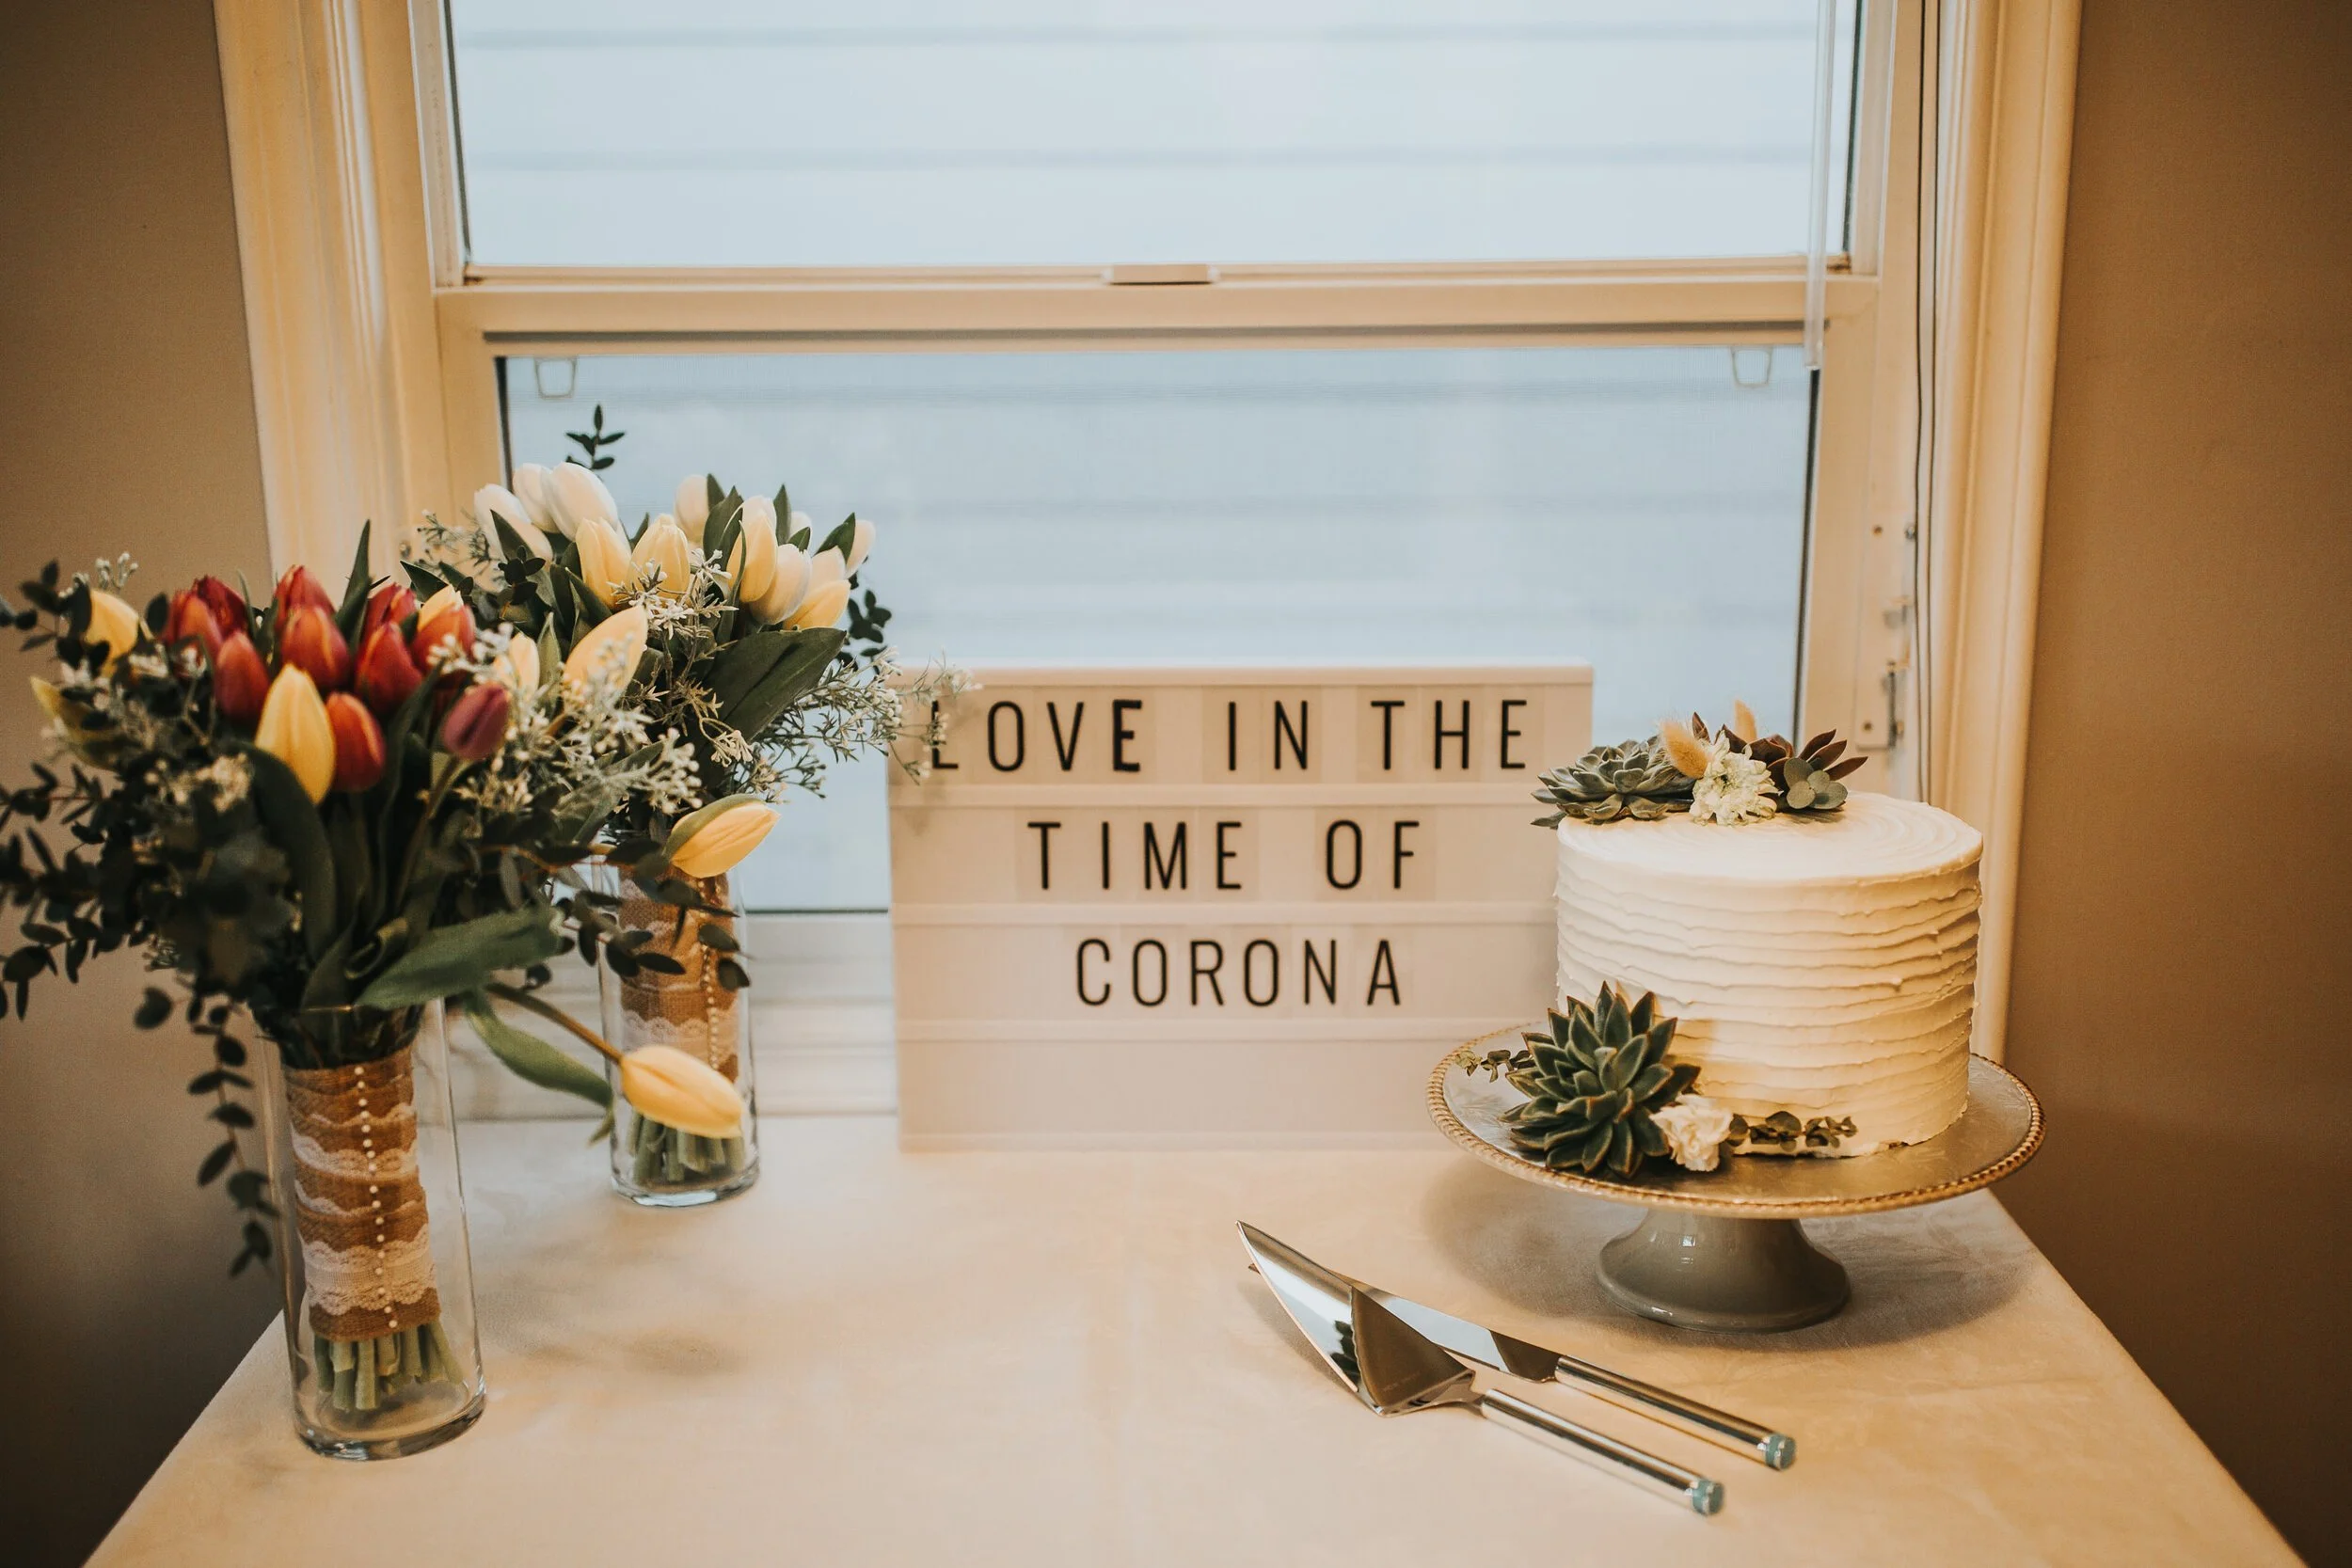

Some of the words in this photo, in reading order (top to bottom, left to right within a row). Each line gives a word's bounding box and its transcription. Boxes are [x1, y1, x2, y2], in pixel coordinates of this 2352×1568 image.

[930, 699, 1143, 771] LOVE
[1228, 700, 1308, 771] IN
[1370, 699, 1528, 770] THE
[1026, 820, 1243, 891] TIME
[1325, 818, 1421, 891] OF
[1076, 938, 1401, 1007] CORONA
